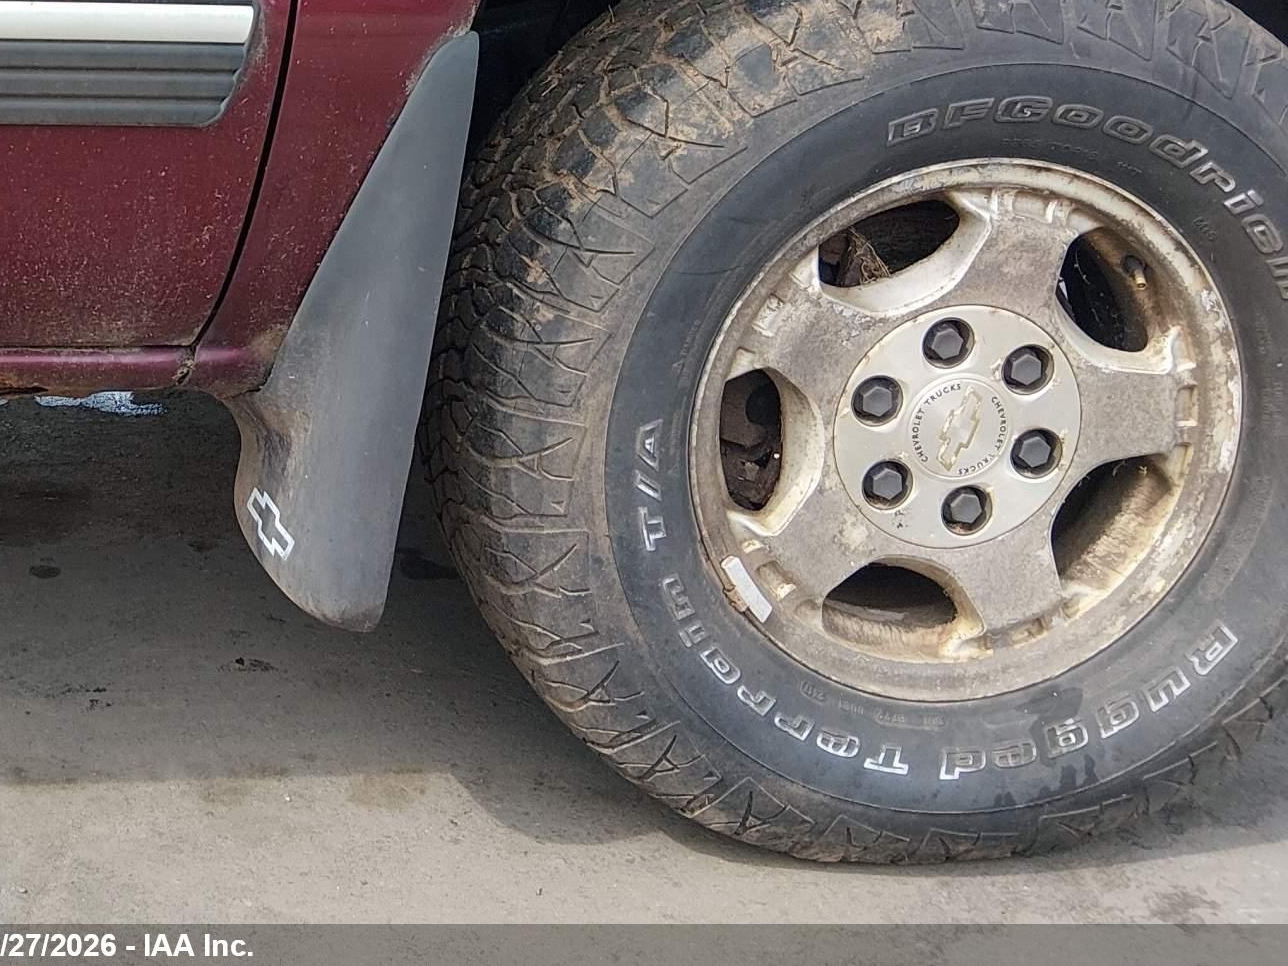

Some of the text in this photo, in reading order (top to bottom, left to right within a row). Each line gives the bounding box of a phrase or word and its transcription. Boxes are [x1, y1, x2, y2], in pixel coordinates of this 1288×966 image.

[912, 382, 961, 463] CHEVROLET TRUCKS
[958, 395, 1007, 476] CHEVROLET TRUCKS
[635, 418, 1239, 781] Rugged Terrain T/A
